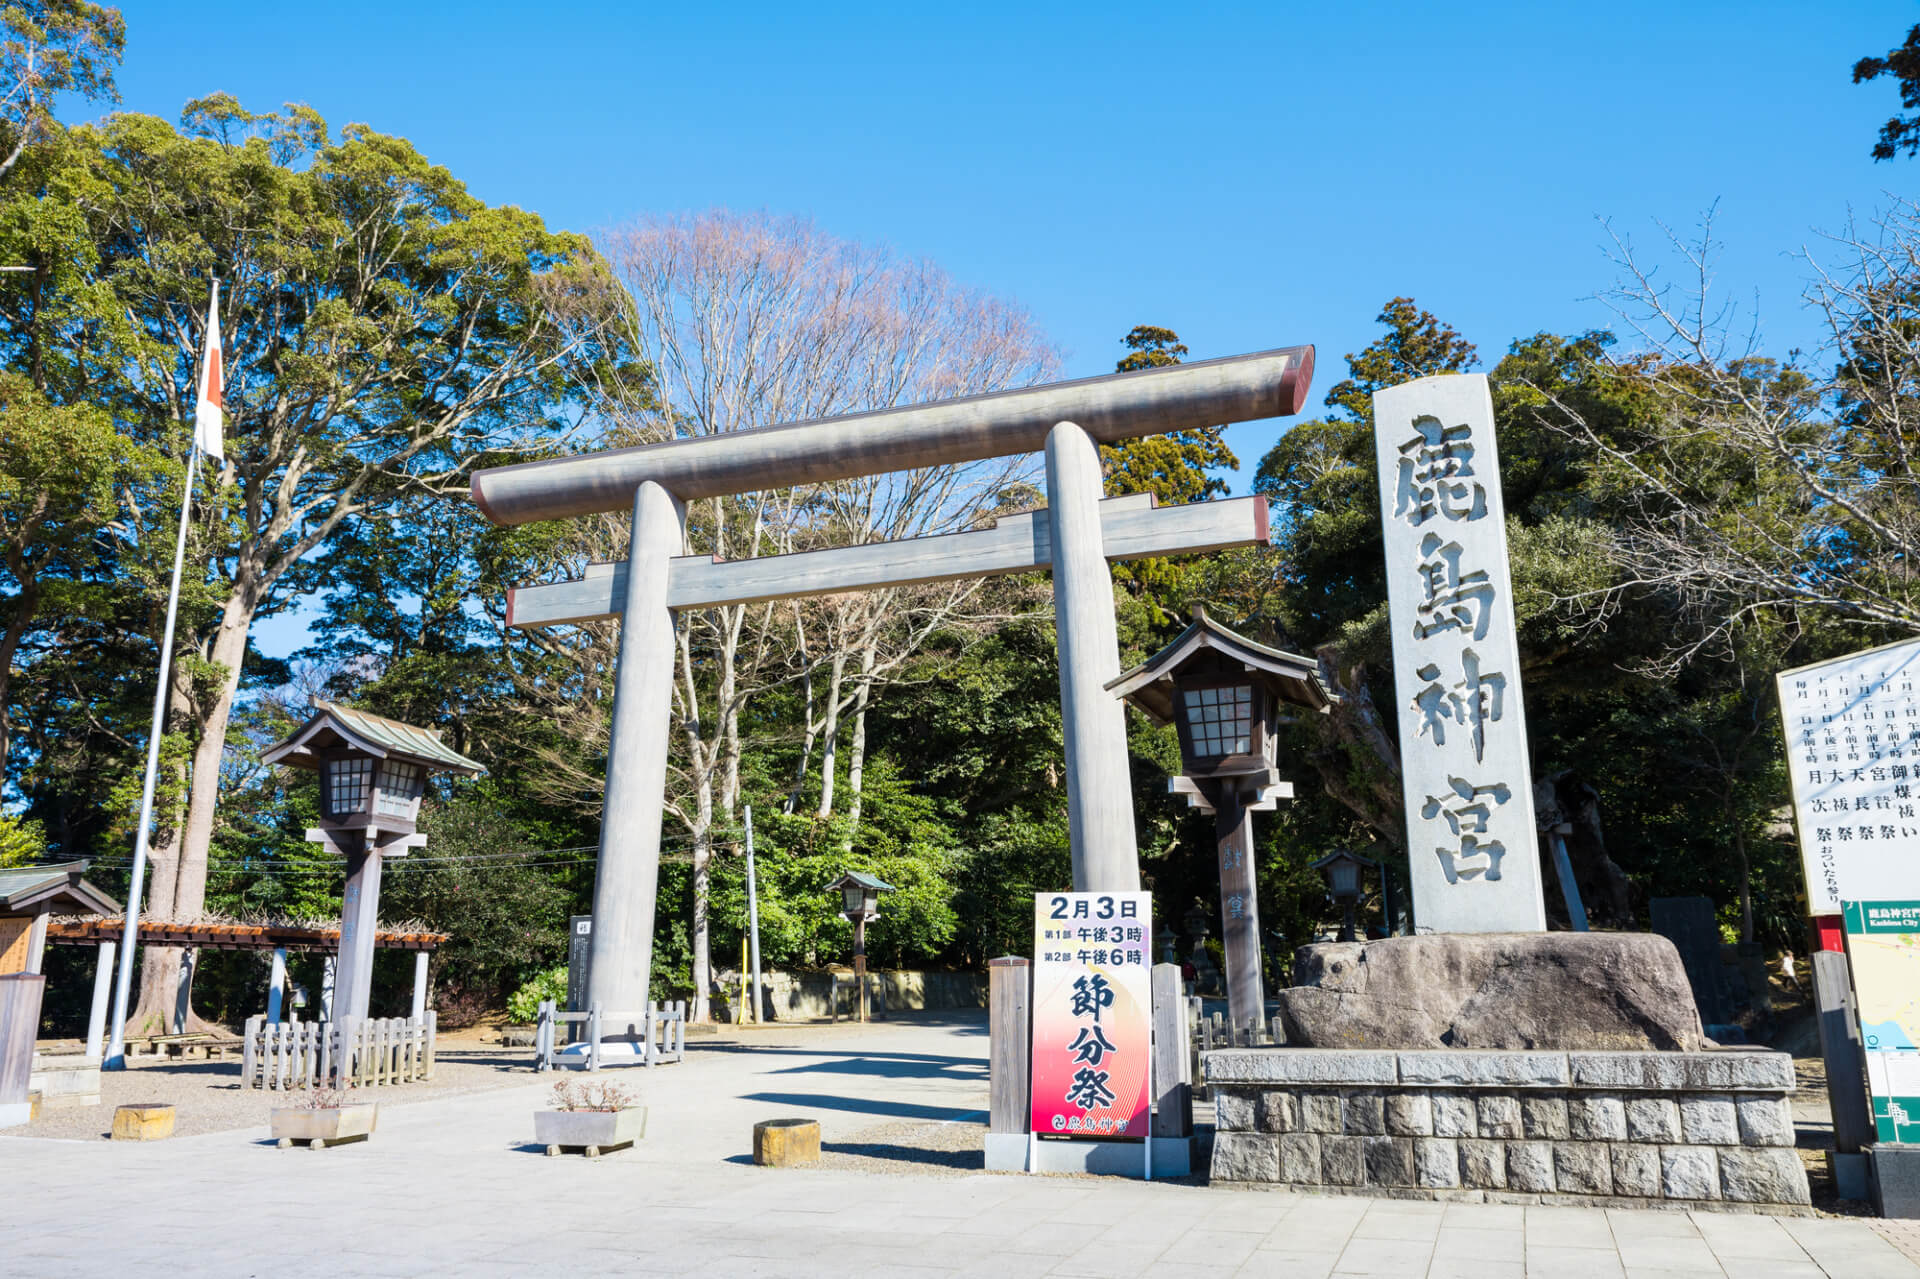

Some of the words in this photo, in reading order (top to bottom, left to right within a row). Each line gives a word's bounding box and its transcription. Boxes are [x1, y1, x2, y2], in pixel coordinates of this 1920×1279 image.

[1393, 414, 1512, 885] 鹿島神宮
[1809, 770, 1832, 842] 月次祭
[1849, 768, 1874, 840] 天長祭
[1044, 929, 1072, 941] 第1部
[1077, 926, 1142, 943] 午後3時
[1050, 896, 1137, 919] 2月3日
[1044, 952, 1072, 963] 第2部
[1077, 949, 1142, 966] 午後6時
[1065, 973, 1117, 1110] 節分祭
